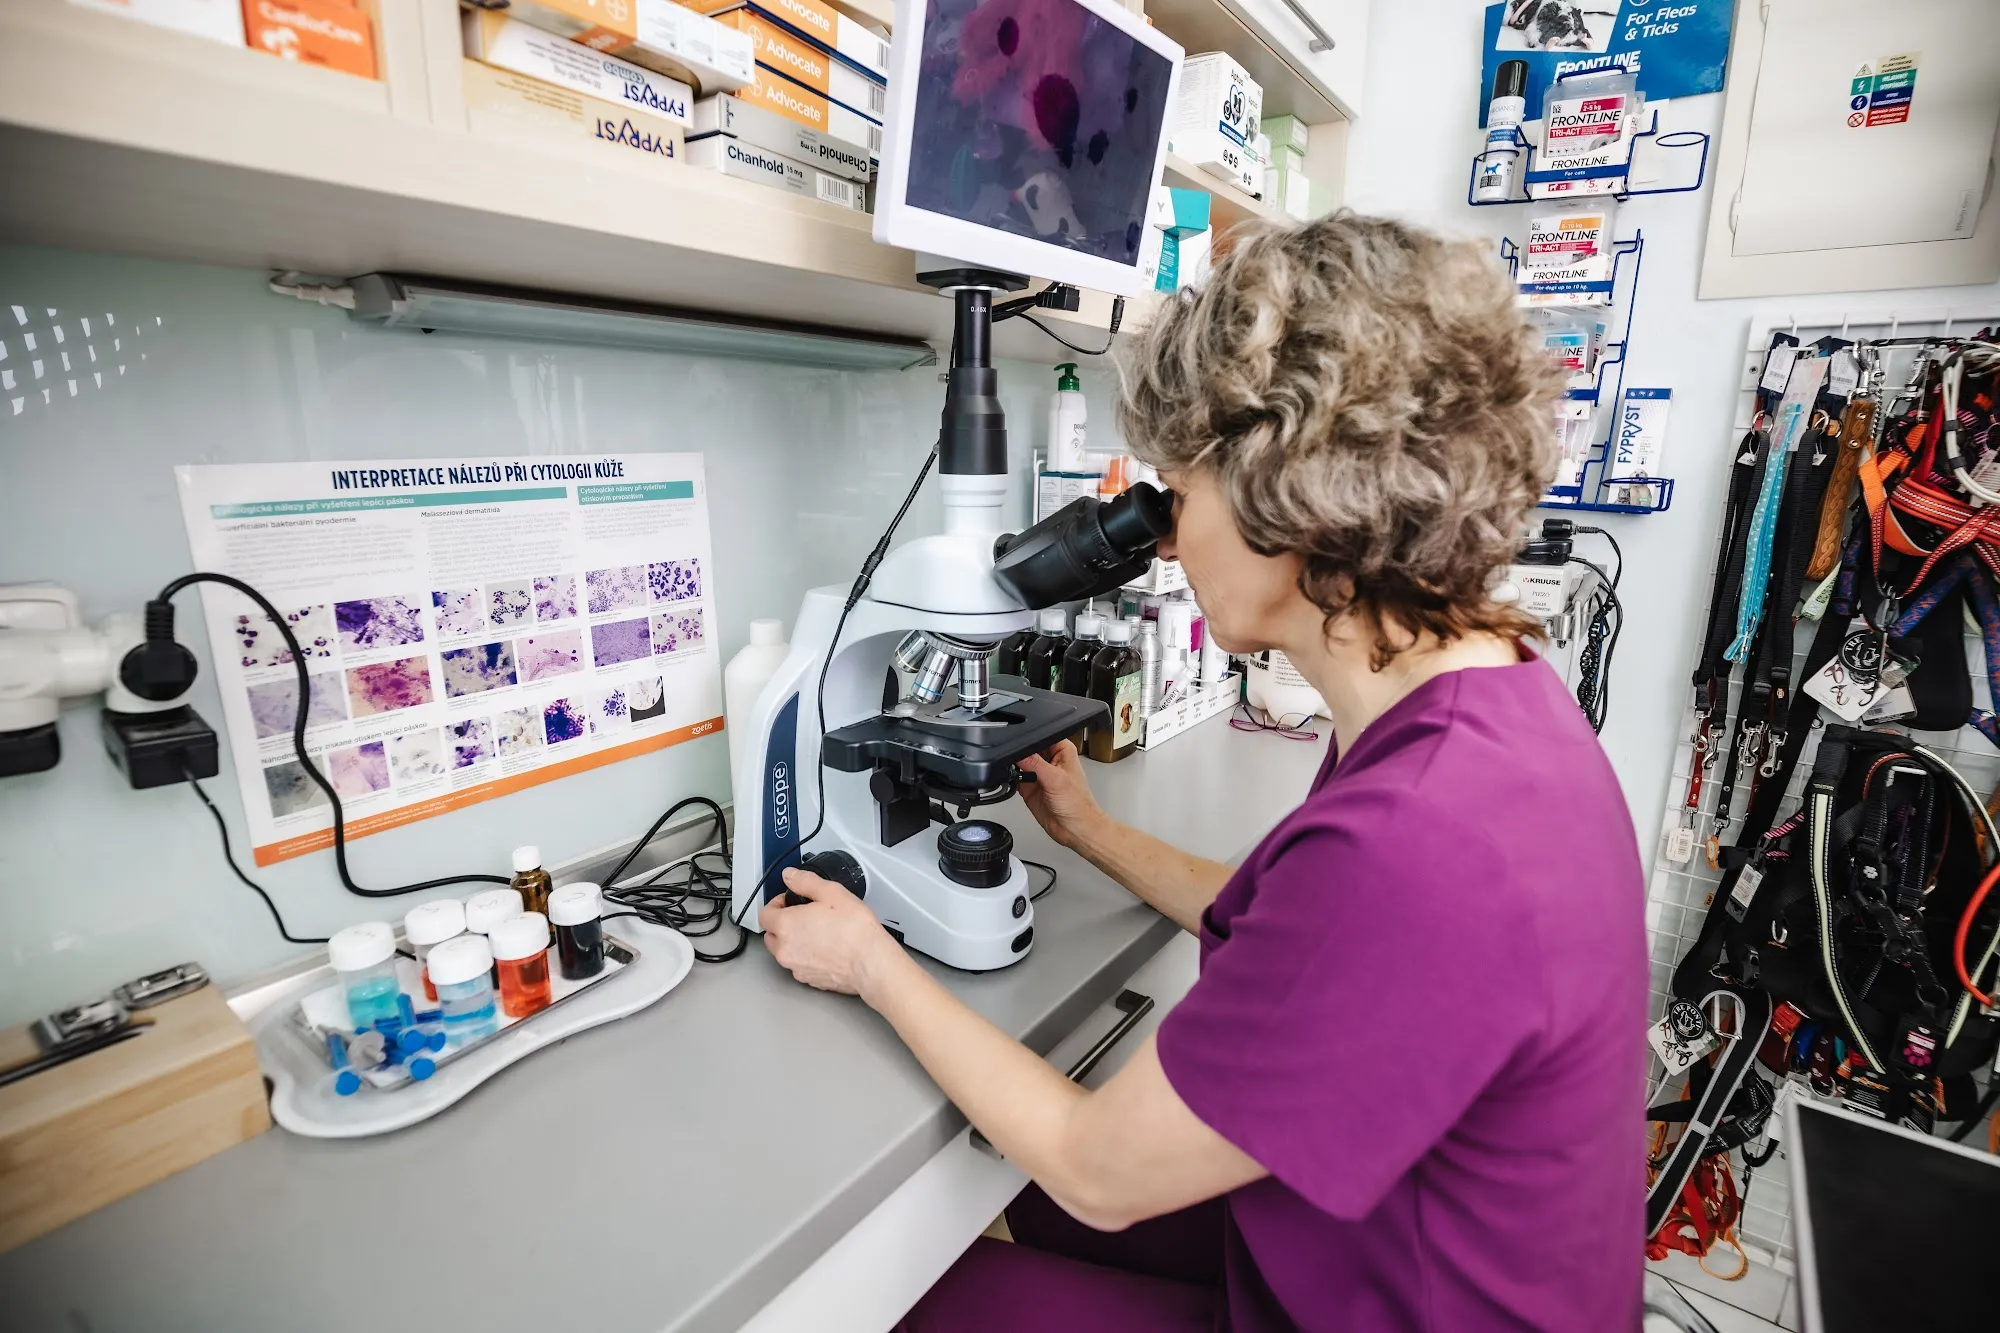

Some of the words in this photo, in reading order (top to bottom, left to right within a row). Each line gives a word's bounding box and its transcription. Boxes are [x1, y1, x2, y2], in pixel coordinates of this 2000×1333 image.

[258, 2, 364, 46] CardioCare
[776, 0, 830, 32] dvocate
[1625, 12, 1654, 27] For
[1656, 5, 1698, 21] Fleas
[1625, 28, 1638, 41] &
[1643, 22, 1679, 38] Ticks
[766, 38, 823, 79] Advocate
[624, 82, 685, 118] FYPRYST
[766, 85, 821, 122] Advocate
[1551, 110, 1621, 127] FRONTLINE
[596, 118, 674, 158] FYPRYST
[1551, 127, 1581, 137] TRI-ACT
[800, 140, 809, 149] mg
[809, 144, 817, 153] 15
[728, 144, 784, 175] Chanhold
[786, 165, 794, 174] 15
[794, 169, 803, 178] mg
[819, 144, 868, 172] Chanhold
[1551, 156, 1610, 169] FRONTLINE
[1530, 230, 1599, 243] FRONTLINE
[1531, 244, 1560, 252] TRI-ACT
[1533, 269, 1589, 280] FRONTLINE
[1617, 404, 1642, 464] FYPRYST
[332, 467, 445, 490] INTERPRETACE
[448, 462, 501, 485] NÁLEZŮ
[505, 462, 527, 482] PŘI
[531, 462, 592, 481] CYTOLOGII
[595, 458, 625, 478] KŮŽE
[580, 486, 615, 496] Cytologické
[274, 503, 304, 514] nálezy
[306, 502, 319, 511] při
[321, 499, 361, 510] vyšetření
[386, 496, 414, 507] páskou
[420, 509, 464, 518] Malasseziová
[464, 507, 501, 516] dermatitida
[270, 518, 314, 528] bakteriální
[315, 516, 357, 527] pyodermie
[1530, 577, 1561, 586] KRUUSE
[1845, 636, 1863, 652] TRE
[325, 738, 352, 750] získané
[354, 732, 382, 743] otiskem
[404, 721, 428, 733] páskou
[692, 721, 713, 734] zoetis
[1673, 1004, 1686, 1016] TRE
